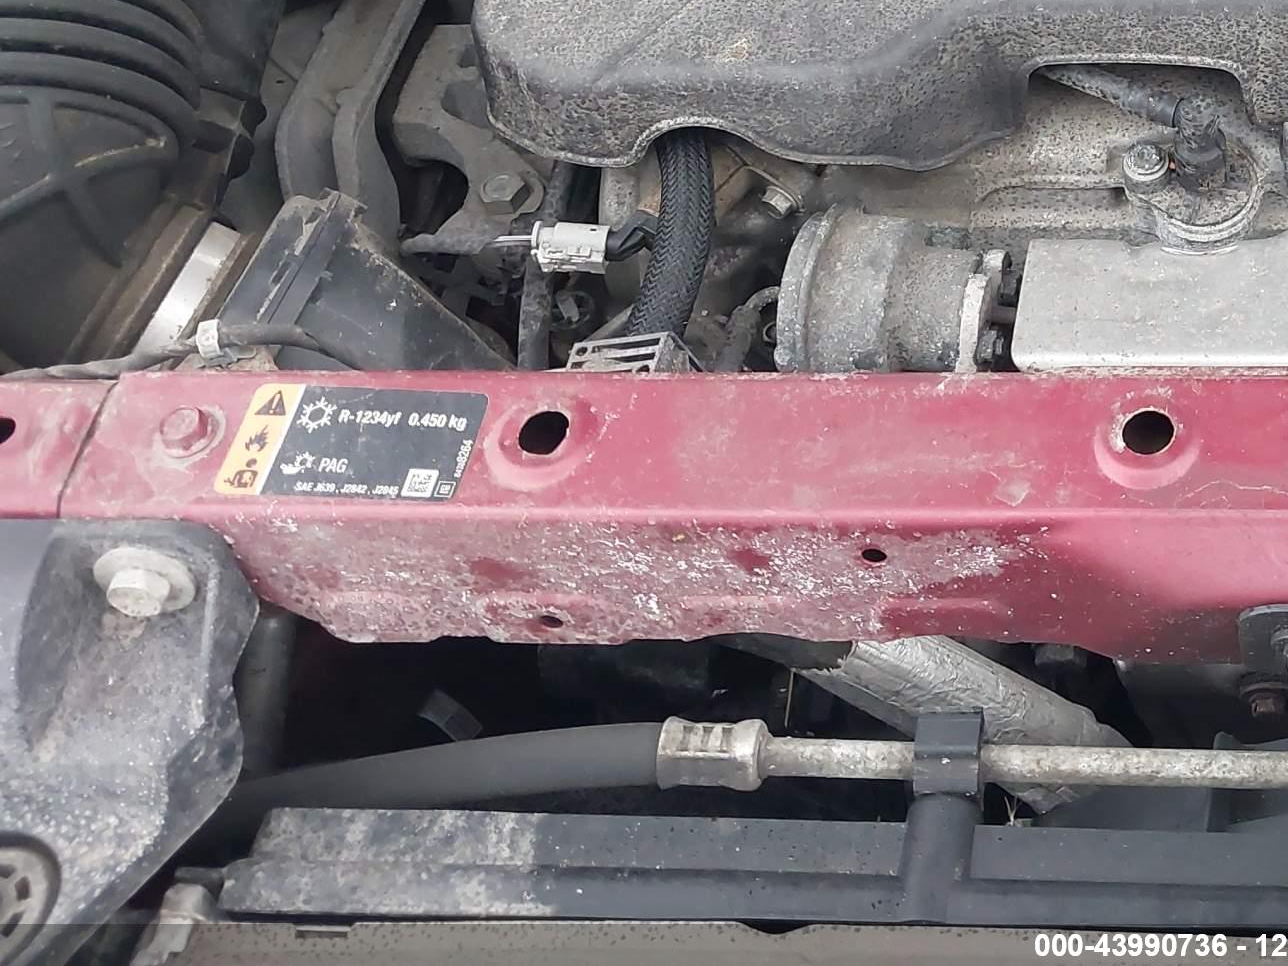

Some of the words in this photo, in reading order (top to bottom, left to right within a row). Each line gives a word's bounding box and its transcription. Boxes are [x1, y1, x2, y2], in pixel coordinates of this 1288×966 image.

[338, 409, 402, 428] R-1234yf
[408, 412, 447, 428] 0.450
[448, 414, 468, 431] kg
[318, 457, 348, 474] PAG
[295, 481, 314, 492] SAE
